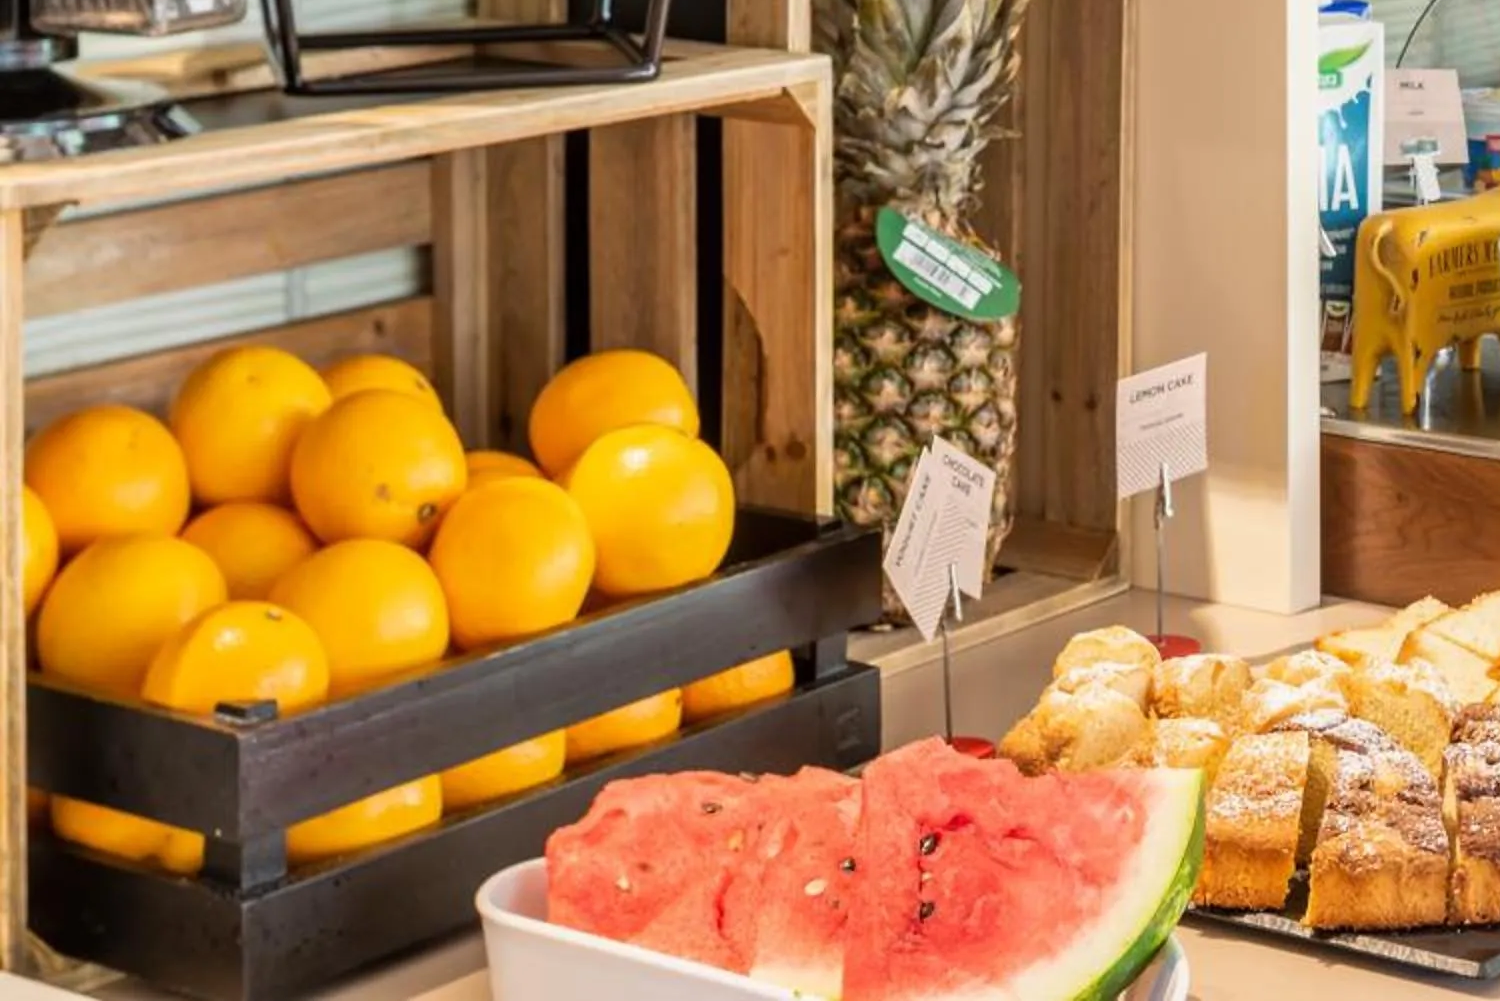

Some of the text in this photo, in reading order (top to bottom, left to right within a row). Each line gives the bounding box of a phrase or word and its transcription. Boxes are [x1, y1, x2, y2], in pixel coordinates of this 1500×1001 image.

[1129, 374, 1193, 404] LEMON CAKE
[942, 454, 985, 489] CHOCOLATE
